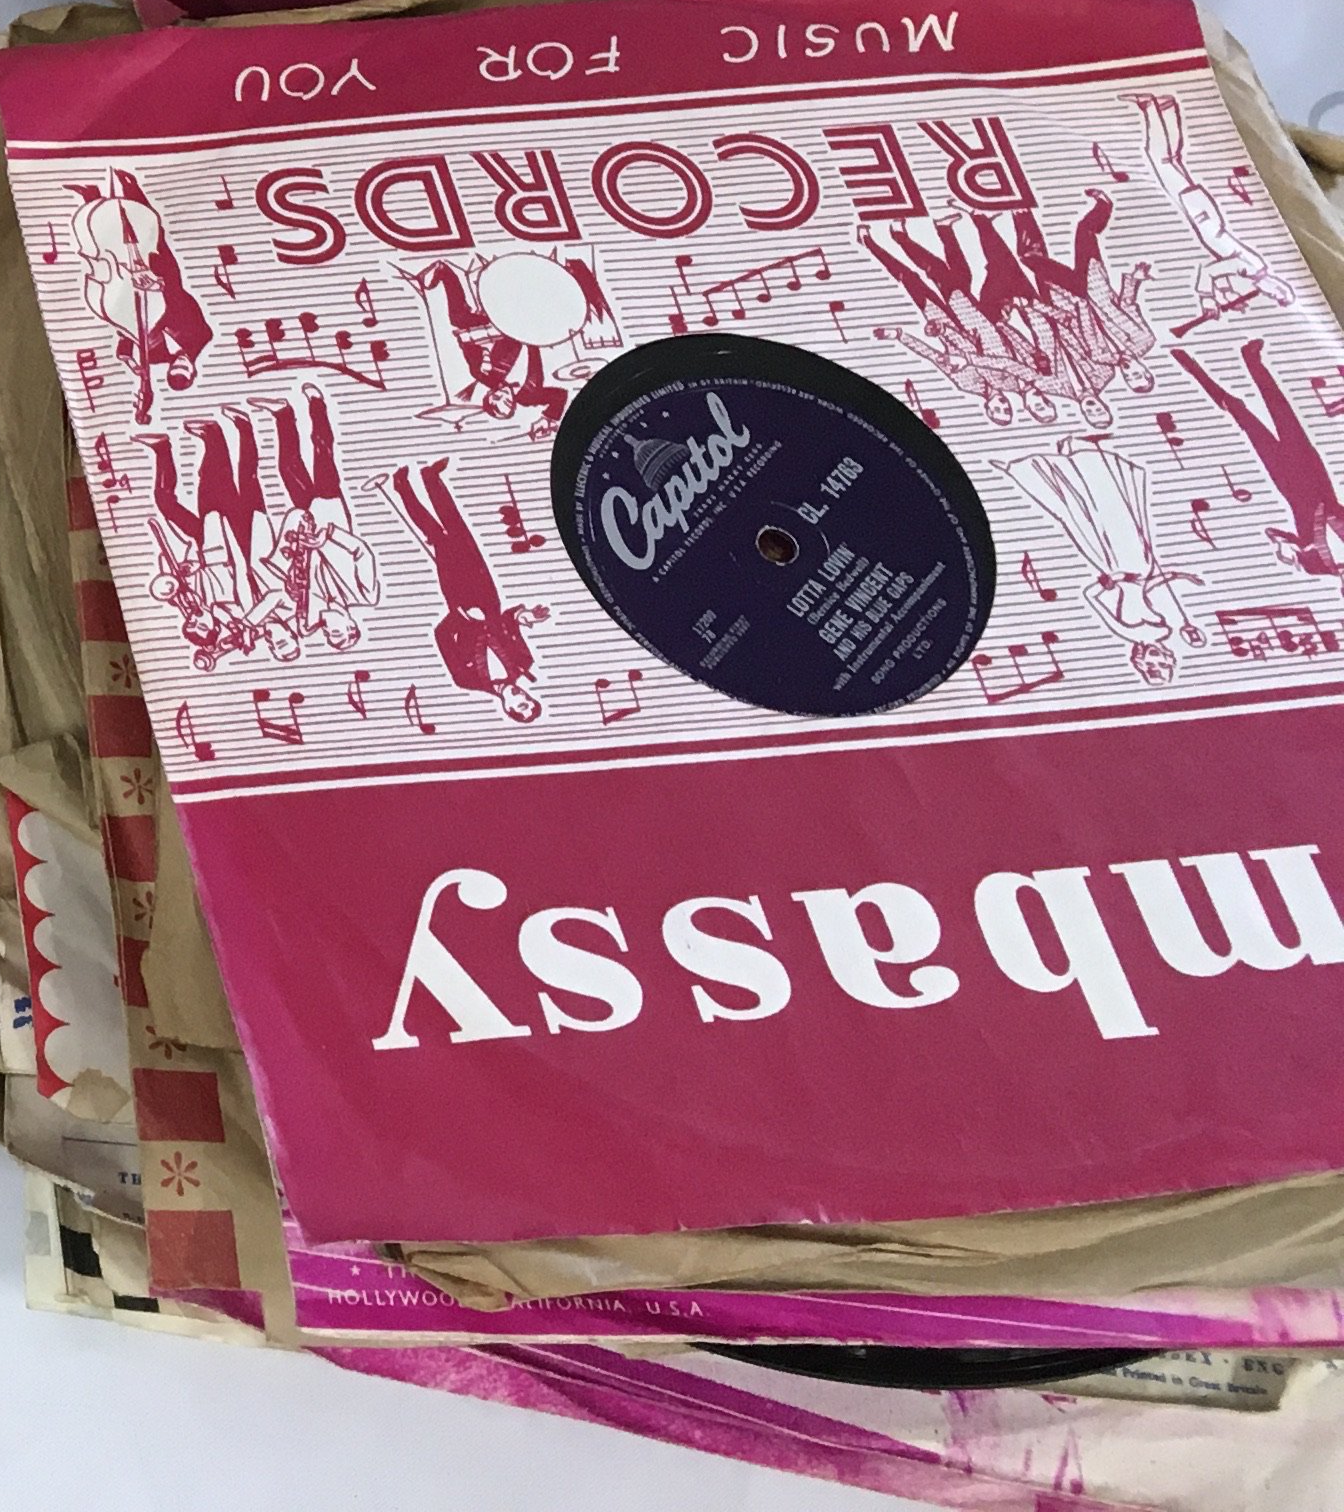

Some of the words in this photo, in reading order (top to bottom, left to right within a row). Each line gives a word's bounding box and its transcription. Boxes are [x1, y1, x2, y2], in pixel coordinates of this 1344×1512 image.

[478, 34, 621, 81] FOR
[720, 11, 957, 66] MUSIC
[234, 60, 377, 105] YOU
[253, 116, 1040, 267] RECORDS
[600, 391, 751, 571] Capitol
[797, 497, 831, 526] CL.
[785, 580, 825, 618] LOTTA
[818, 541, 857, 583] LOVIN'
[818, 609, 854, 644] GENE
[844, 561, 894, 612] VINCENT
[326, 1288, 464, 1308] HOLLYWOO
